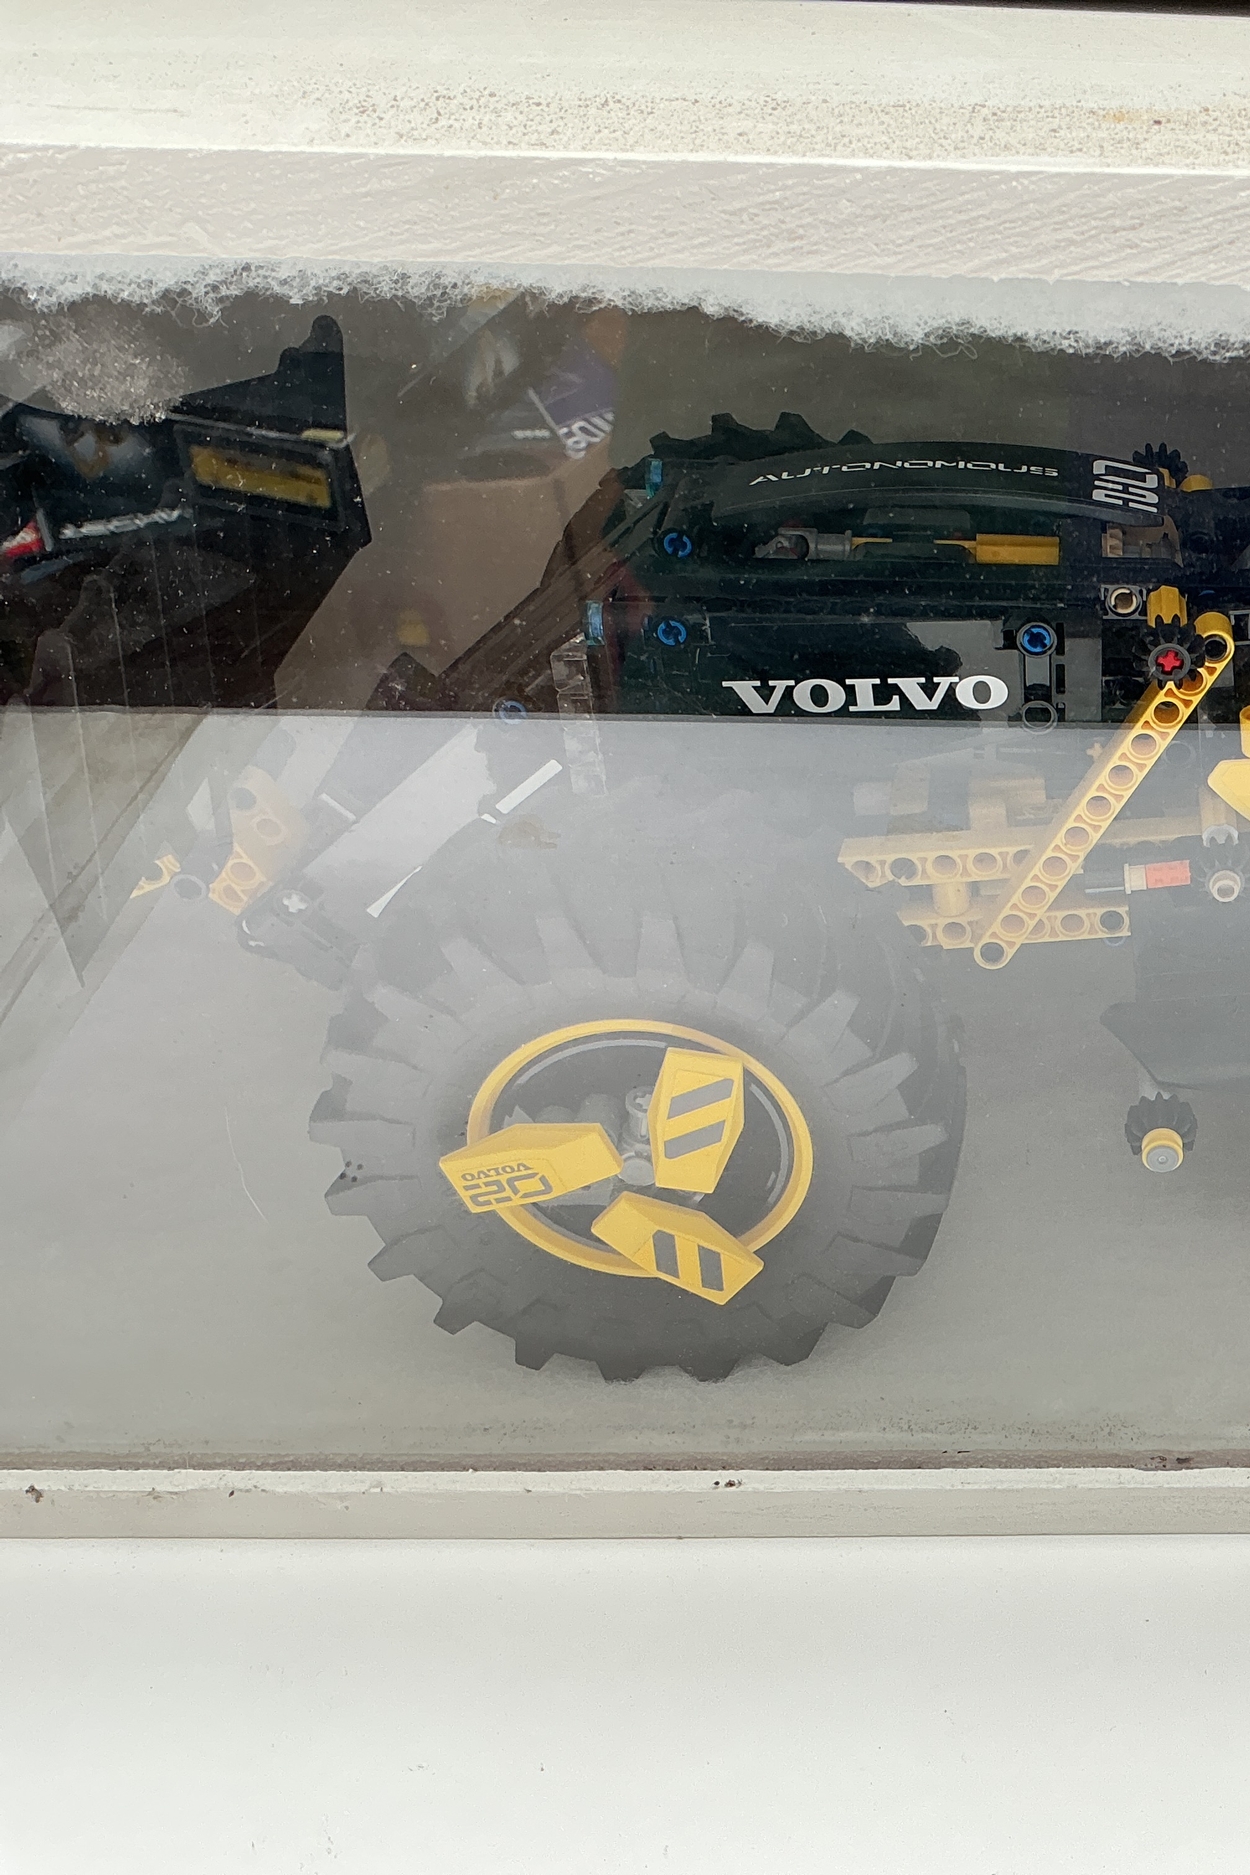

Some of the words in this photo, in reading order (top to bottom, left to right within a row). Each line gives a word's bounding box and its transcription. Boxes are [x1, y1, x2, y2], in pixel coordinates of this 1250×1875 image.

[749, 460, 1058, 485] AUTONOMOUS
[721, 675, 1008, 714] VOLVO
[461, 1162, 534, 1182] VOLVO
